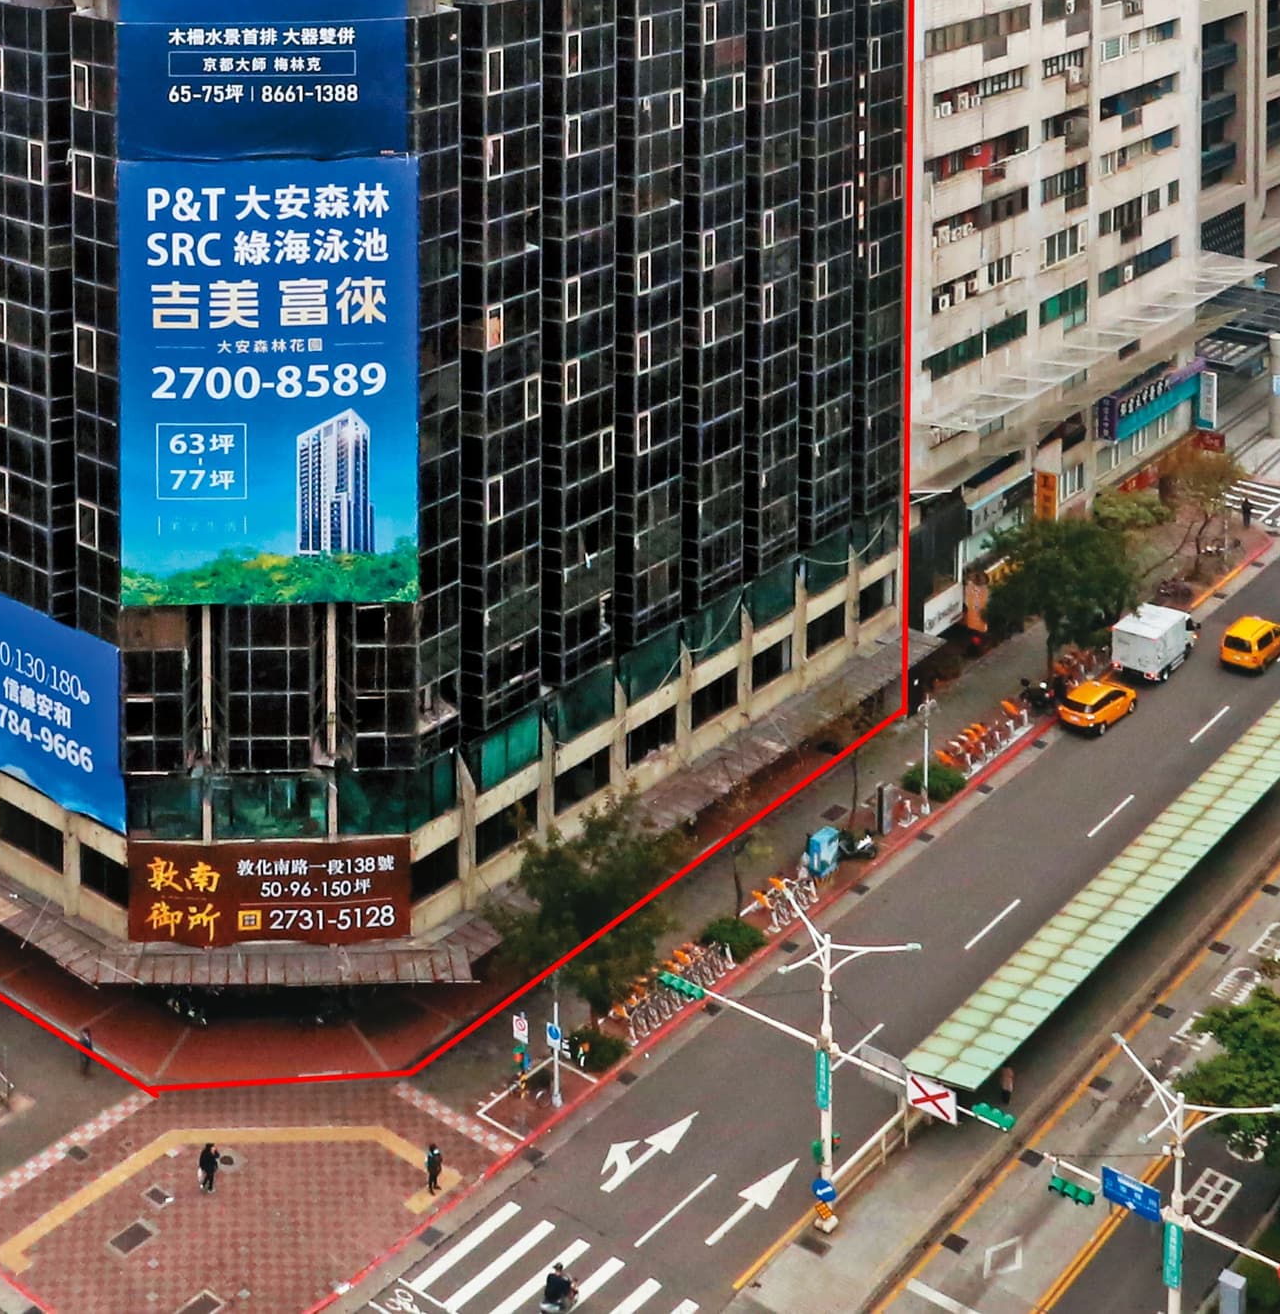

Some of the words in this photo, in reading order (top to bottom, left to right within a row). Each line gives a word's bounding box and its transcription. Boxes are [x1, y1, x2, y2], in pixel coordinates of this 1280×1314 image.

[168, 28, 277, 46] 木柵水景首排
[283, 27, 356, 46] 大器雙併
[203, 57, 266, 73] 京都大師
[274, 56, 322, 72] 梅林克
[168, 84, 244, 103] 65-75坪
[261, 84, 359, 103] 8661-1388
[146, 186, 226, 223] P&T
[235, 182, 390, 221] 大安森林
[146, 232, 221, 267] SRC
[234, 229, 389, 266] 綠海泳池
[151, 279, 260, 330] 吉美
[151, 363, 388, 400] 2700-8589
[169, 433, 236, 455] 63坪
[170, 469, 236, 492] 77坪
[2, 675, 72, 729] 信義安和
[268, 904, 396, 932] 2731-5128
